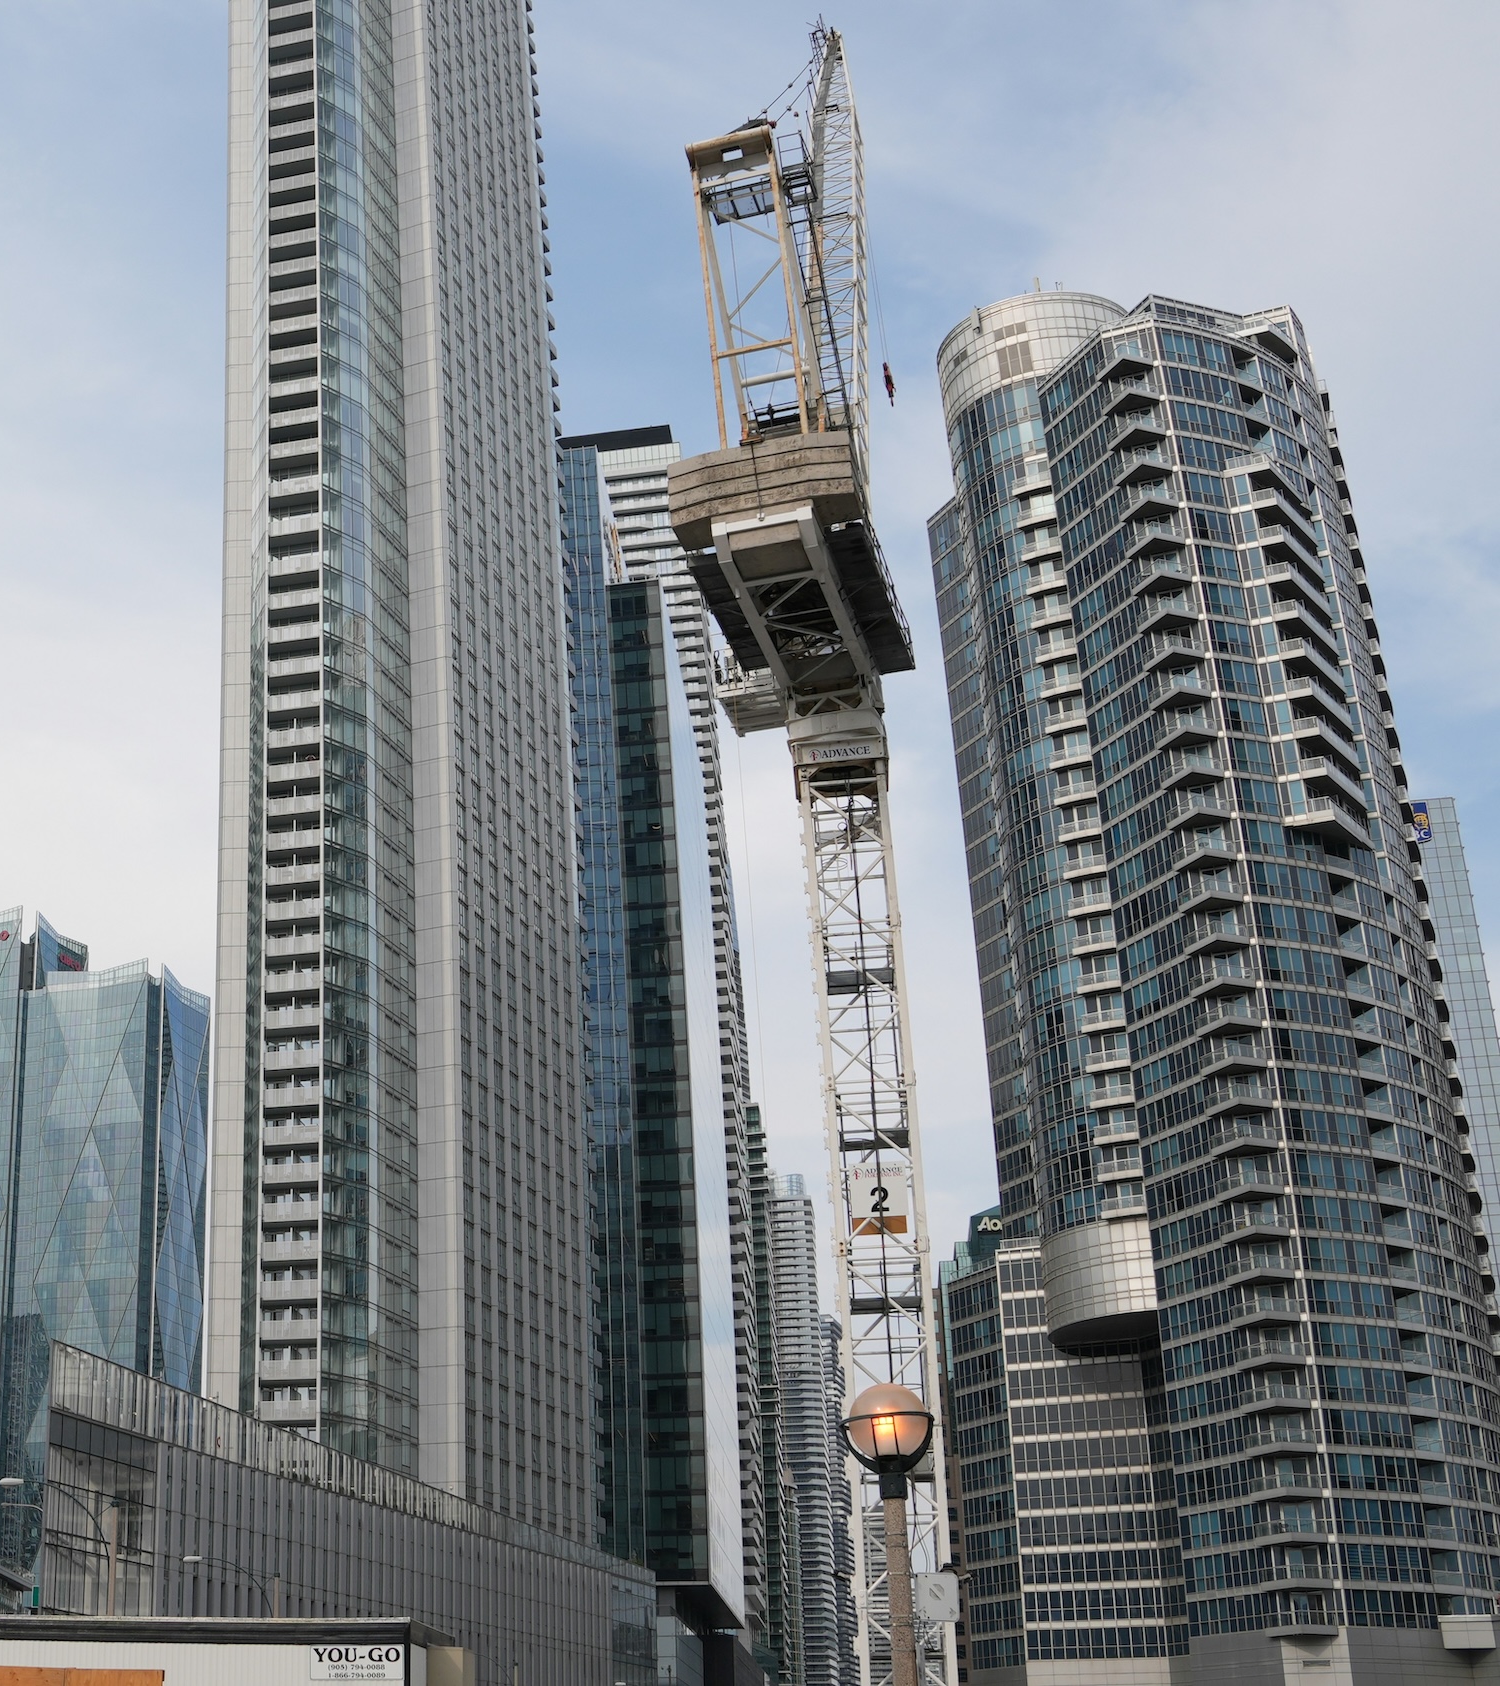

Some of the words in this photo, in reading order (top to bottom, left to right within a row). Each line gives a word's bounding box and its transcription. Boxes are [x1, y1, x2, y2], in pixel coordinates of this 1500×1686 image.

[821, 745, 871, 759] ADVANCE
[870, 1186, 890, 1213] 2
[977, 1216, 1003, 1232] Ao
[313, 1647, 401, 1663] YOU-GO
